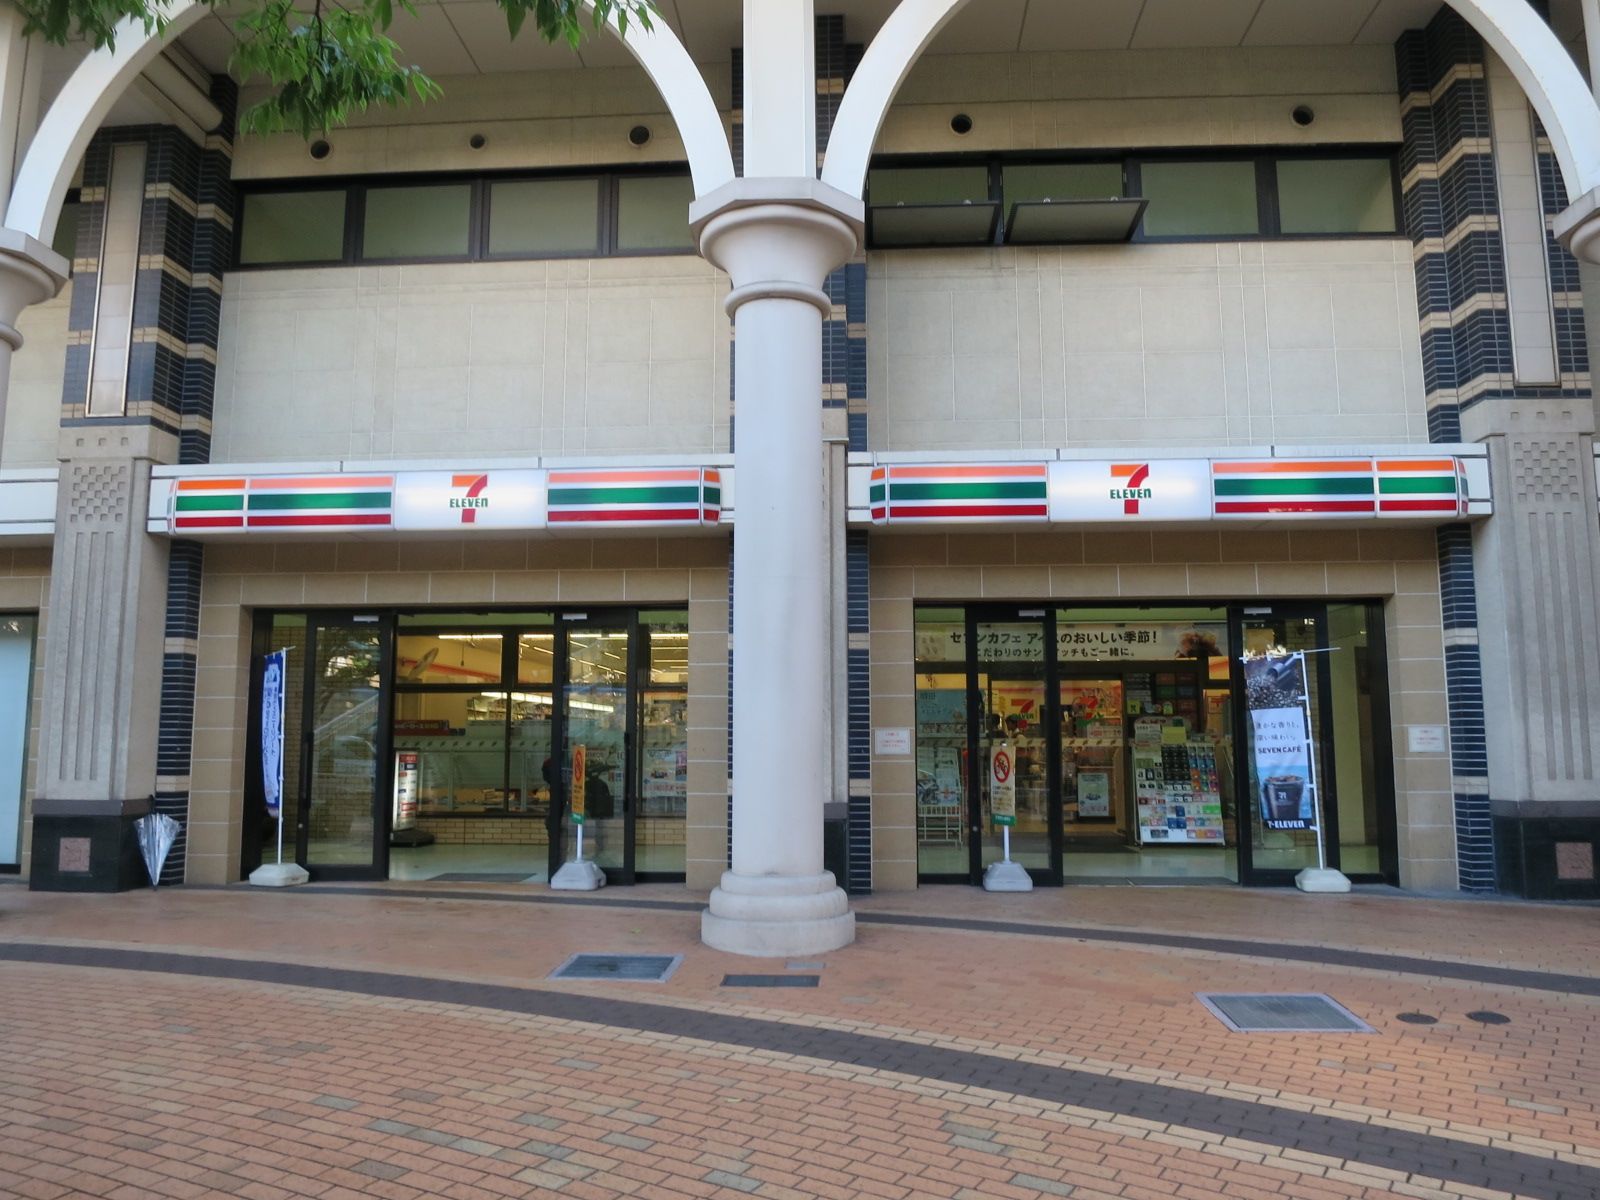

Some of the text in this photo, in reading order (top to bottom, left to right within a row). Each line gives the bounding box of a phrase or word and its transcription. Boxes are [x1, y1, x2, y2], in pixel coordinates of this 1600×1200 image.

[452, 474, 487, 523] 7
[1110, 463, 1149, 514] 7
[950, 630, 1157, 645] センカフェ アのおいしい季節!
[1258, 744, 1302, 754] SEVEN CAFÉ
